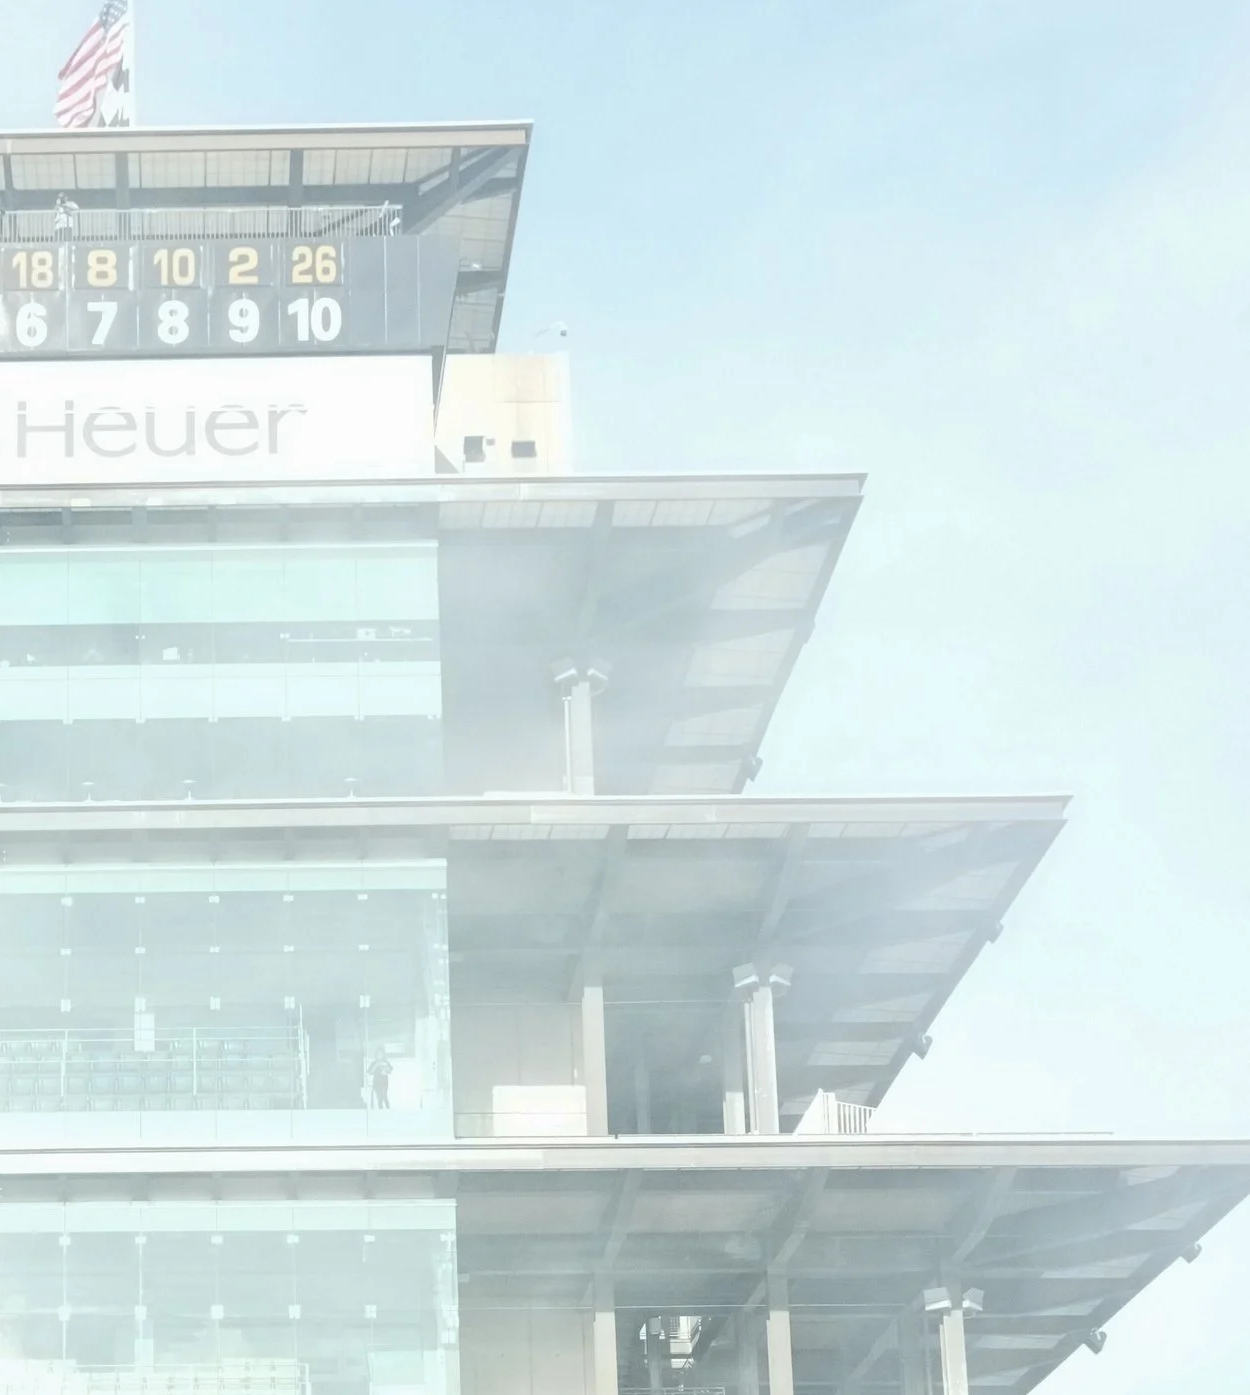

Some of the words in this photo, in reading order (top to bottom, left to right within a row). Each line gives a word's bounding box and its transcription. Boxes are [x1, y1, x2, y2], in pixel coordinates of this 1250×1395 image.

[12, 250, 54, 288] 18
[87, 249, 118, 287] 8
[153, 248, 196, 286] 10
[228, 247, 259, 285] 2
[291, 245, 337, 284] 26
[15, 302, 48, 347] 6
[87, 302, 118, 345] 7
[157, 300, 190, 345] 8
[228, 299, 260, 343] 9
[287, 297, 343, 342] 10
